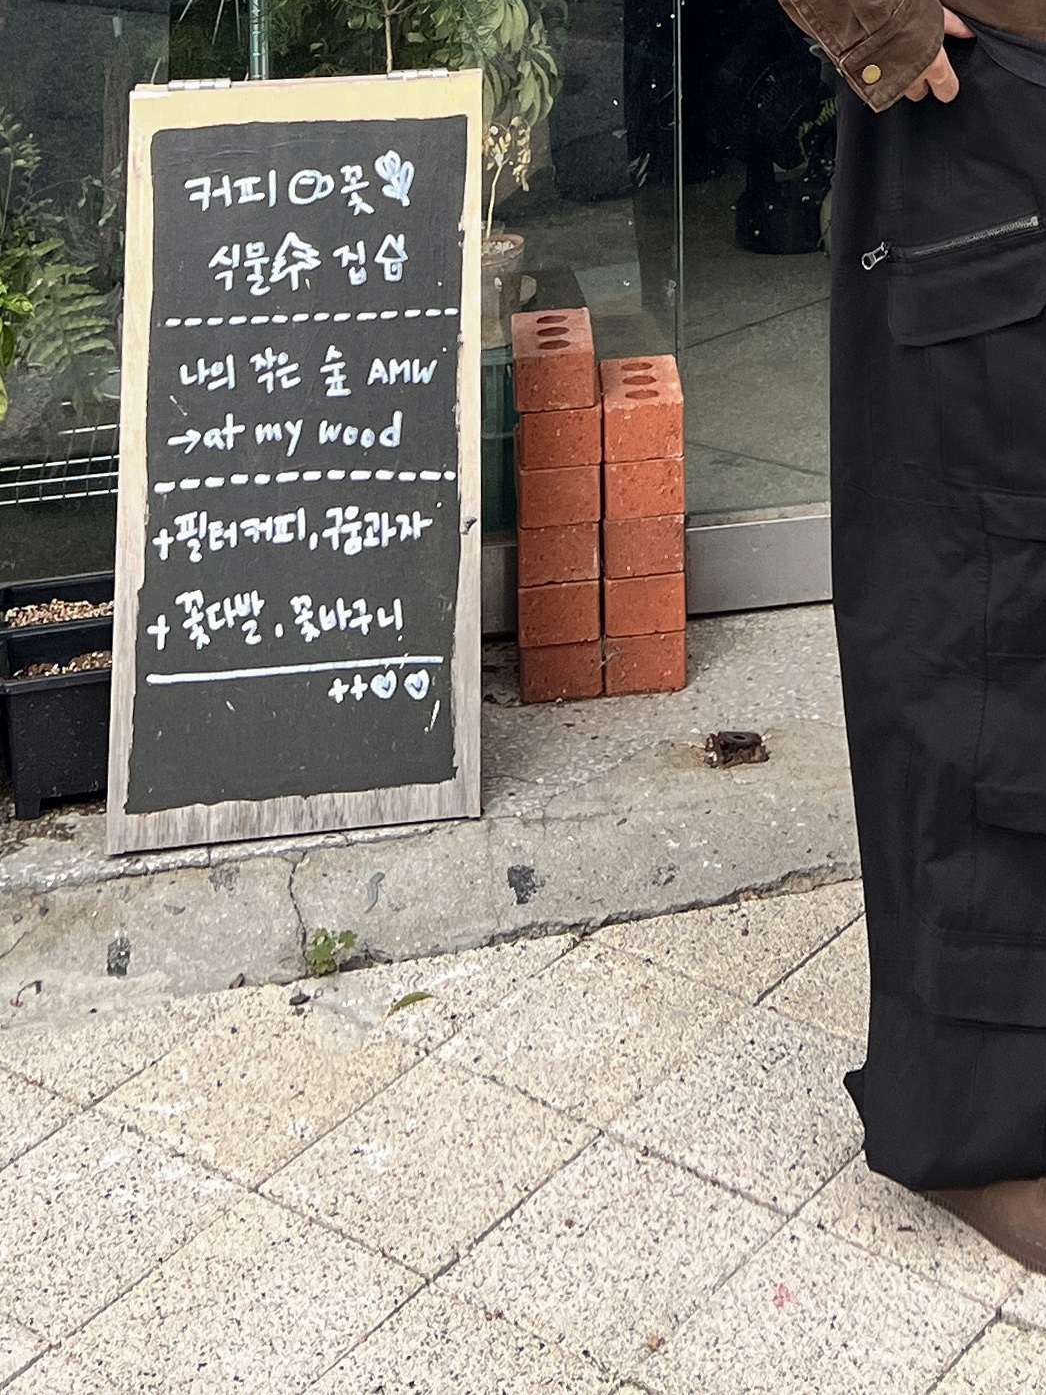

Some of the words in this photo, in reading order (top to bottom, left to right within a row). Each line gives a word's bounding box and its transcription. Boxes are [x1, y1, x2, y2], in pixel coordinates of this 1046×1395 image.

[184, 169, 276, 212] 커피
[340, 165, 375, 216] 꽃
[208, 241, 271, 296] 식물
[332, 240, 367, 286] 집
[179, 354, 235, 391] 나의
[250, 347, 301, 394] 작은
[319, 344, 351, 397] 숲
[366, 358, 438, 385] AMW
[203, 413, 246, 450] at
[255, 419, 304, 457] my
[318, 410, 403, 449] wood
